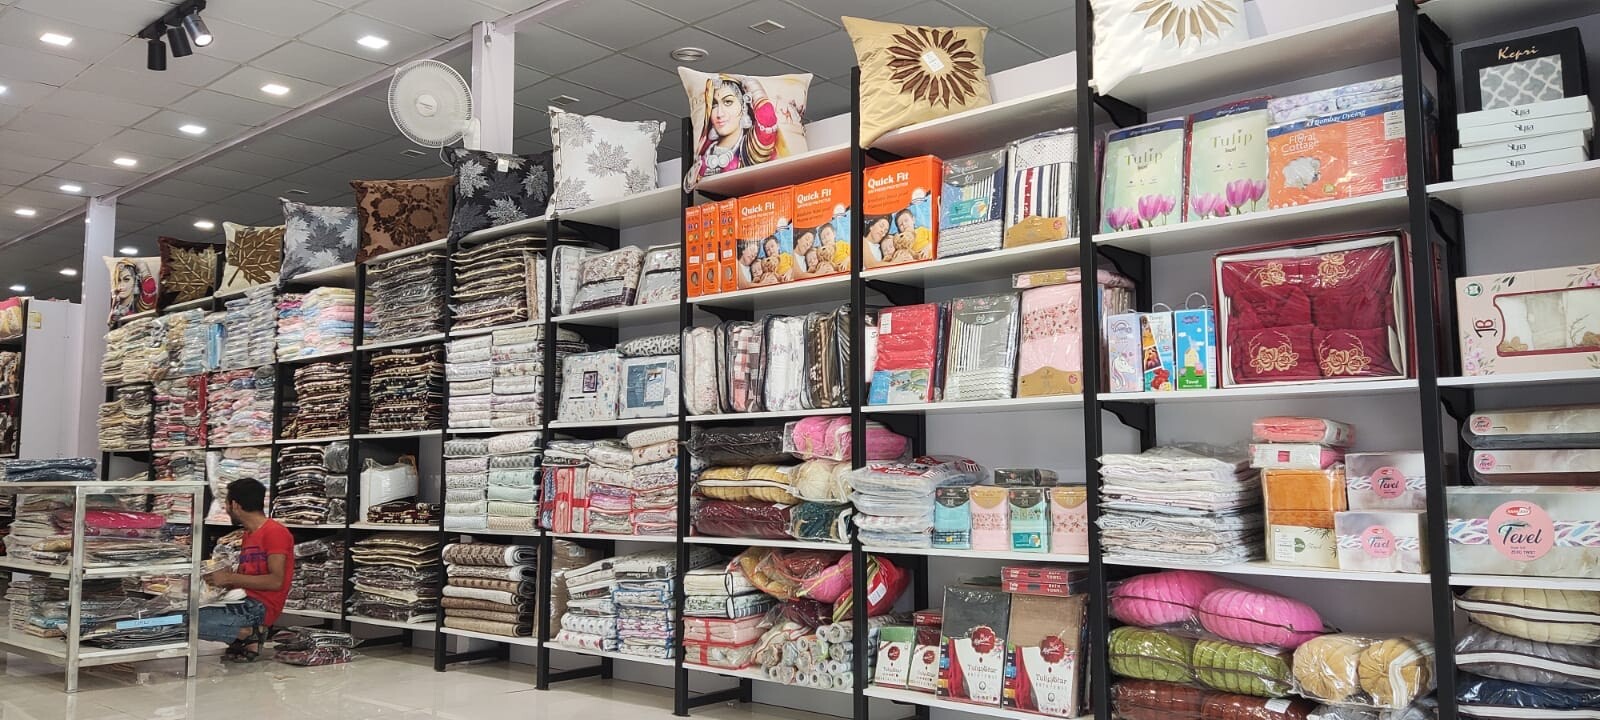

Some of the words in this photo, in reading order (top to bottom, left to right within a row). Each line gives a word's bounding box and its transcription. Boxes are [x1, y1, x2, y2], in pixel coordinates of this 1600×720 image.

[1498, 46, 1540, 60] Kepri
[1342, 110, 1366, 120] Dyeing
[1210, 129, 1252, 148] Tulip
[1289, 132, 1316, 144] Floral
[1281, 140, 1319, 153] Cottage
[1124, 148, 1163, 165] Tulip
[868, 175, 894, 189] Quick
[896, 172, 909, 182] Fit
[797, 192, 819, 204] Quick
[821, 189, 832, 198] Fit
[741, 204, 763, 216] Quick
[765, 202, 775, 210] Fit
[1378, 477, 1400, 490] Tevel
[1498, 523, 1542, 545] Tevel
[1368, 536, 1390, 548] Tevel
